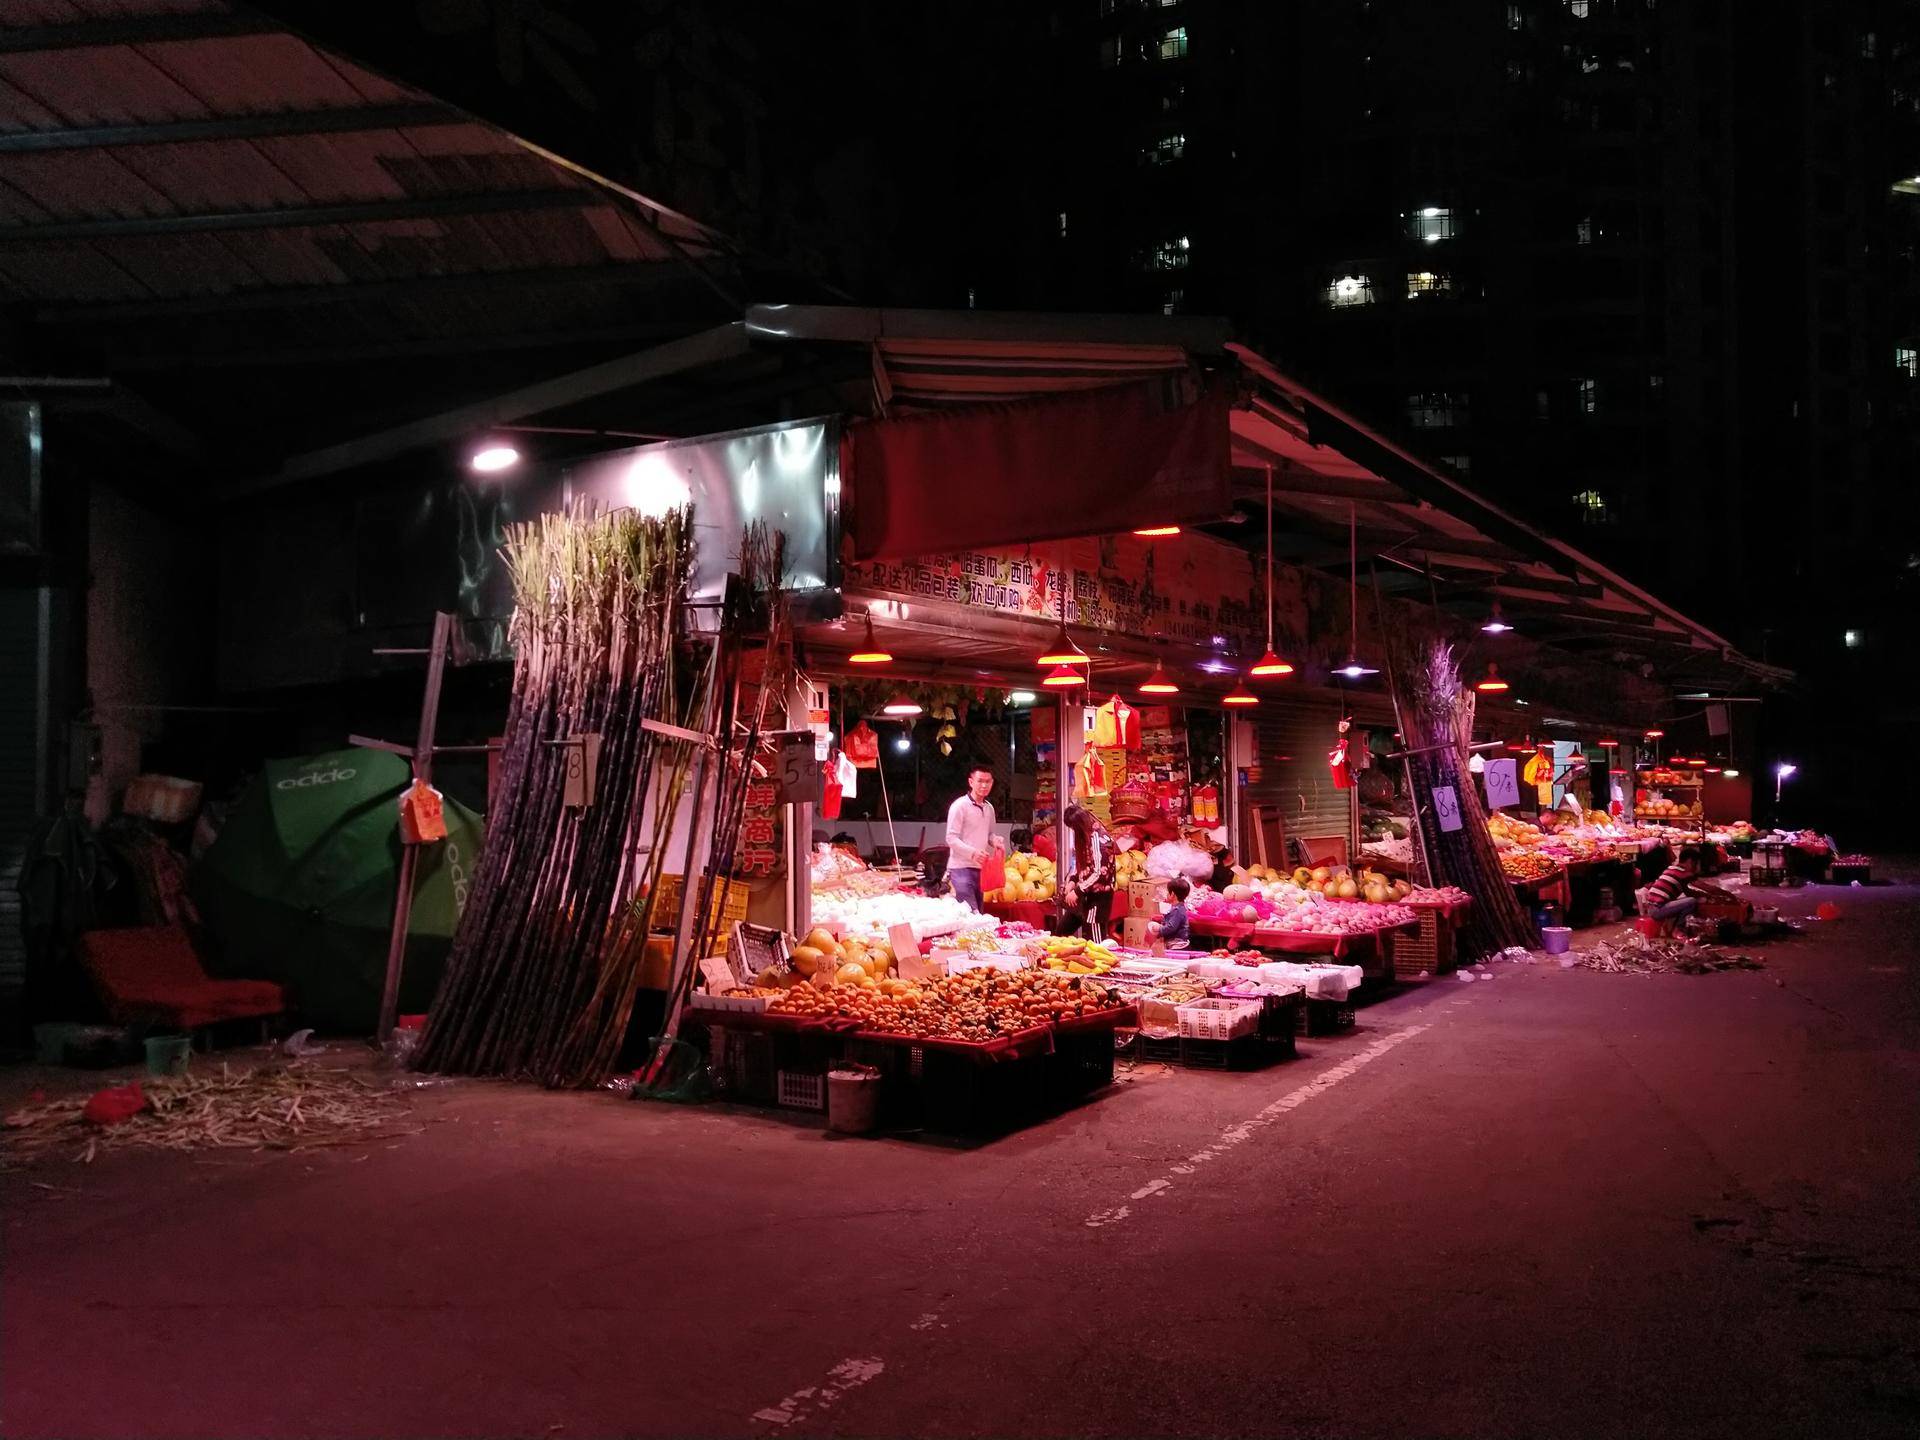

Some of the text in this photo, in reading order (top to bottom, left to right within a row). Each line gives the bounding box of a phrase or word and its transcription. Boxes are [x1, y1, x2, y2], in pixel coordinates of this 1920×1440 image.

[872, 562, 1020, 609] 配送礼品包装 欢迎订购
[569, 752, 581, 779] 8
